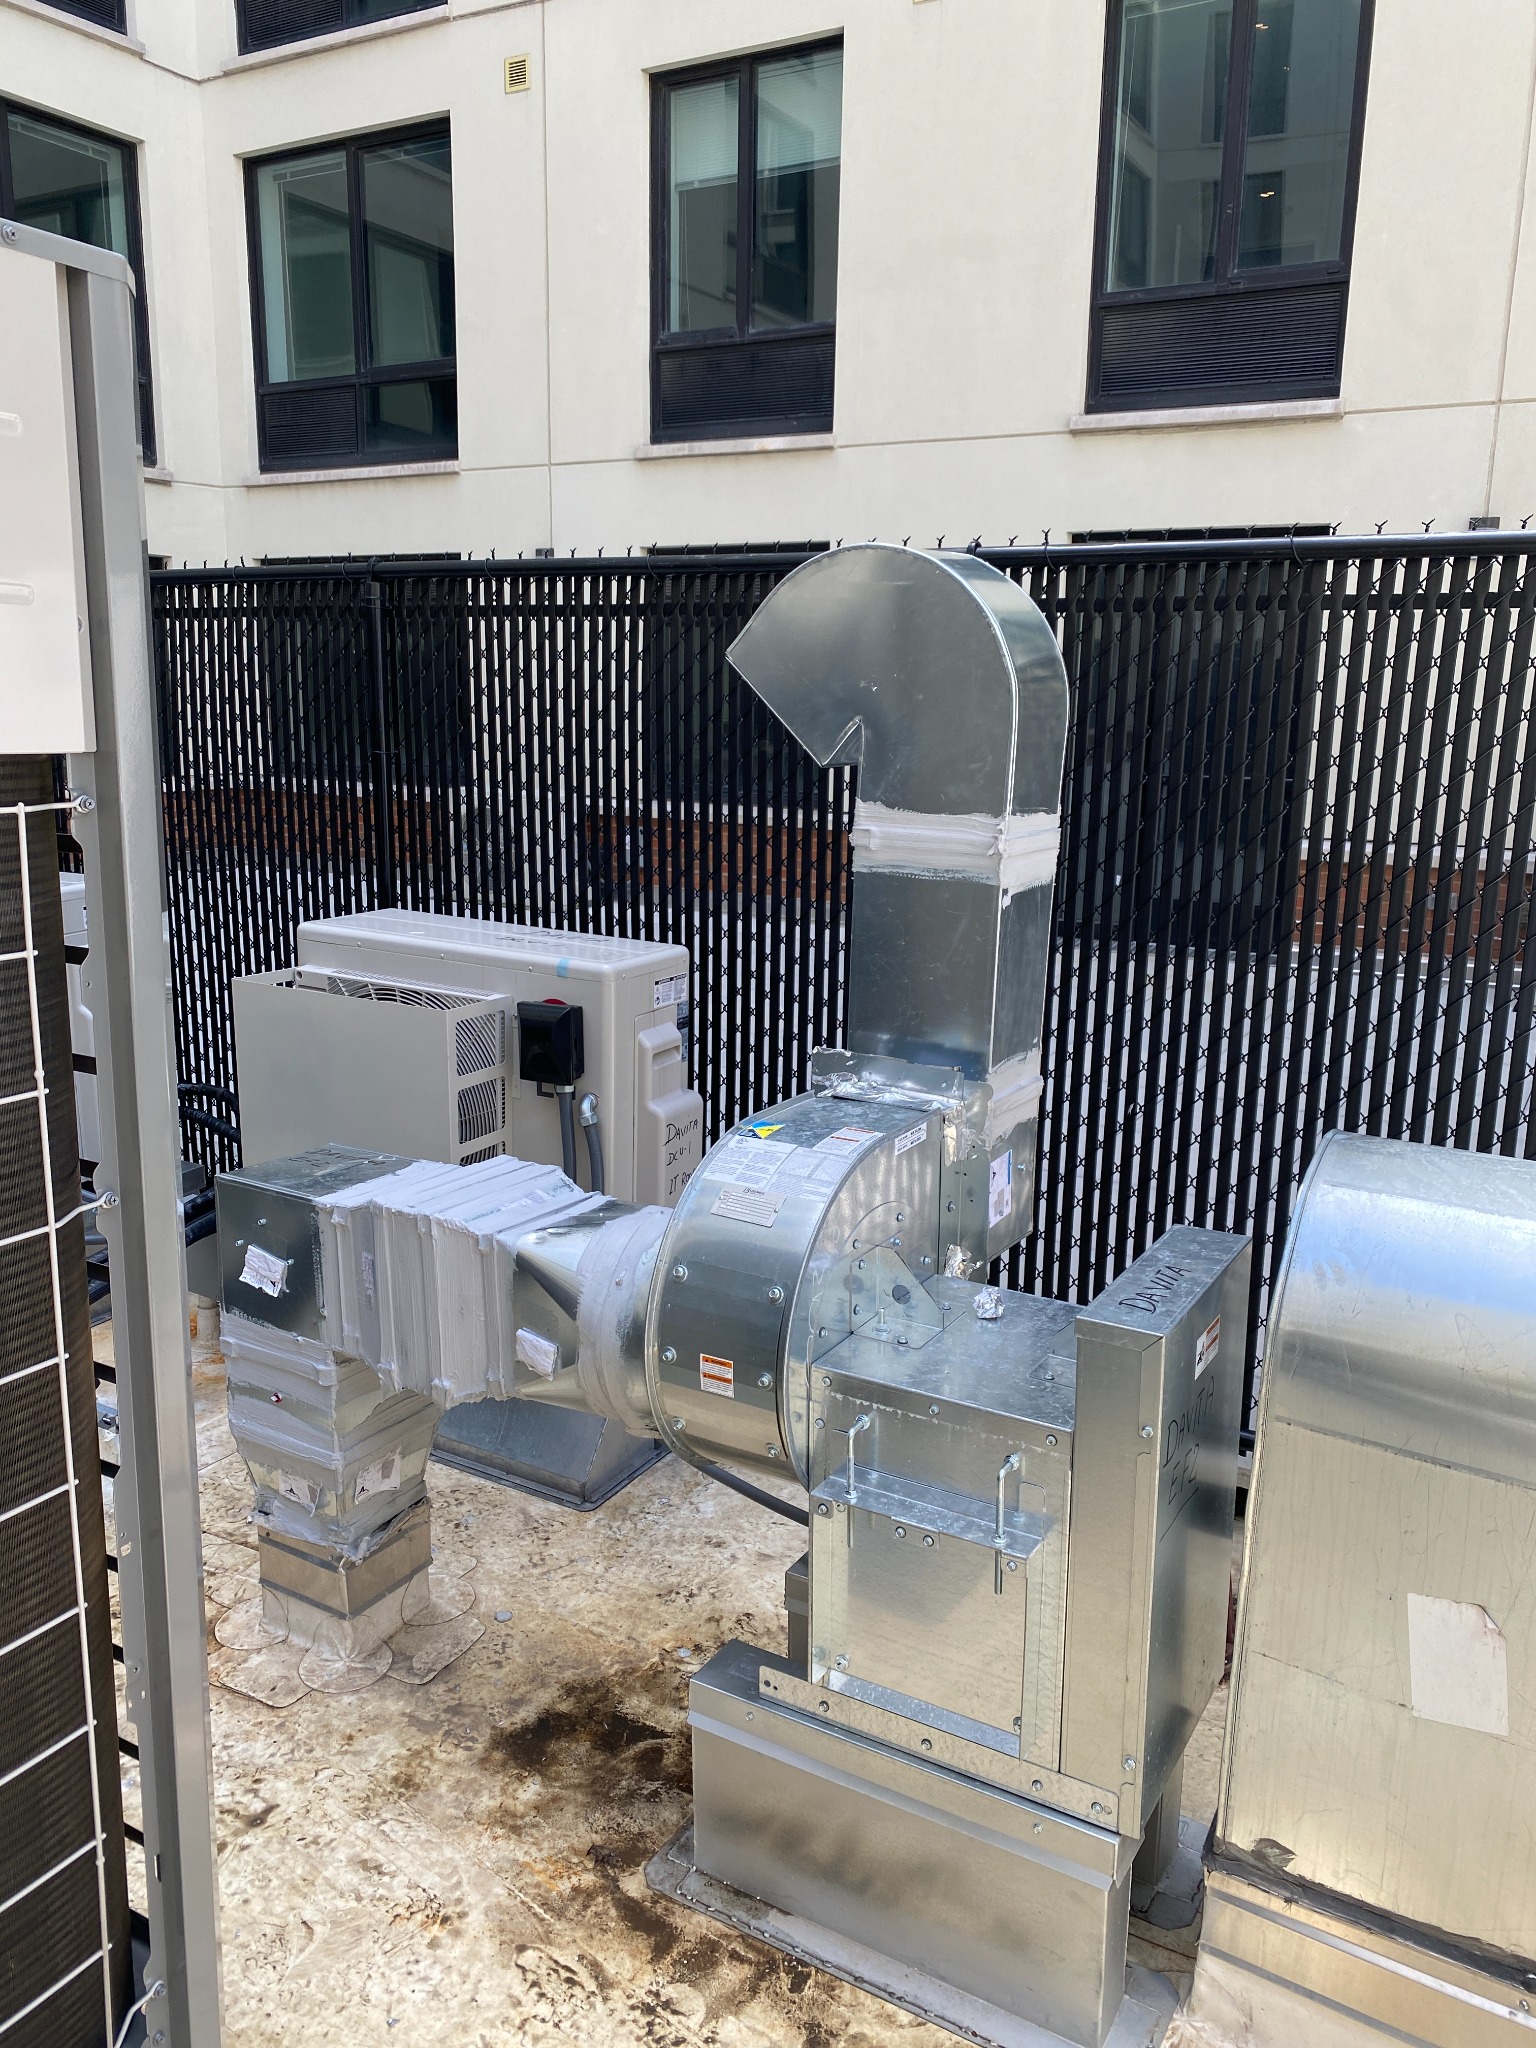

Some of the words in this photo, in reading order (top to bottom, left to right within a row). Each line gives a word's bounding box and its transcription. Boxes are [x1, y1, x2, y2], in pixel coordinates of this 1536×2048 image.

[662, 1119, 698, 1146] DAVITA
[1119, 1265, 1192, 1314] DAVITA
[1163, 1376, 1214, 1468] DAVITA
[1168, 1443, 1200, 1505] EF2
